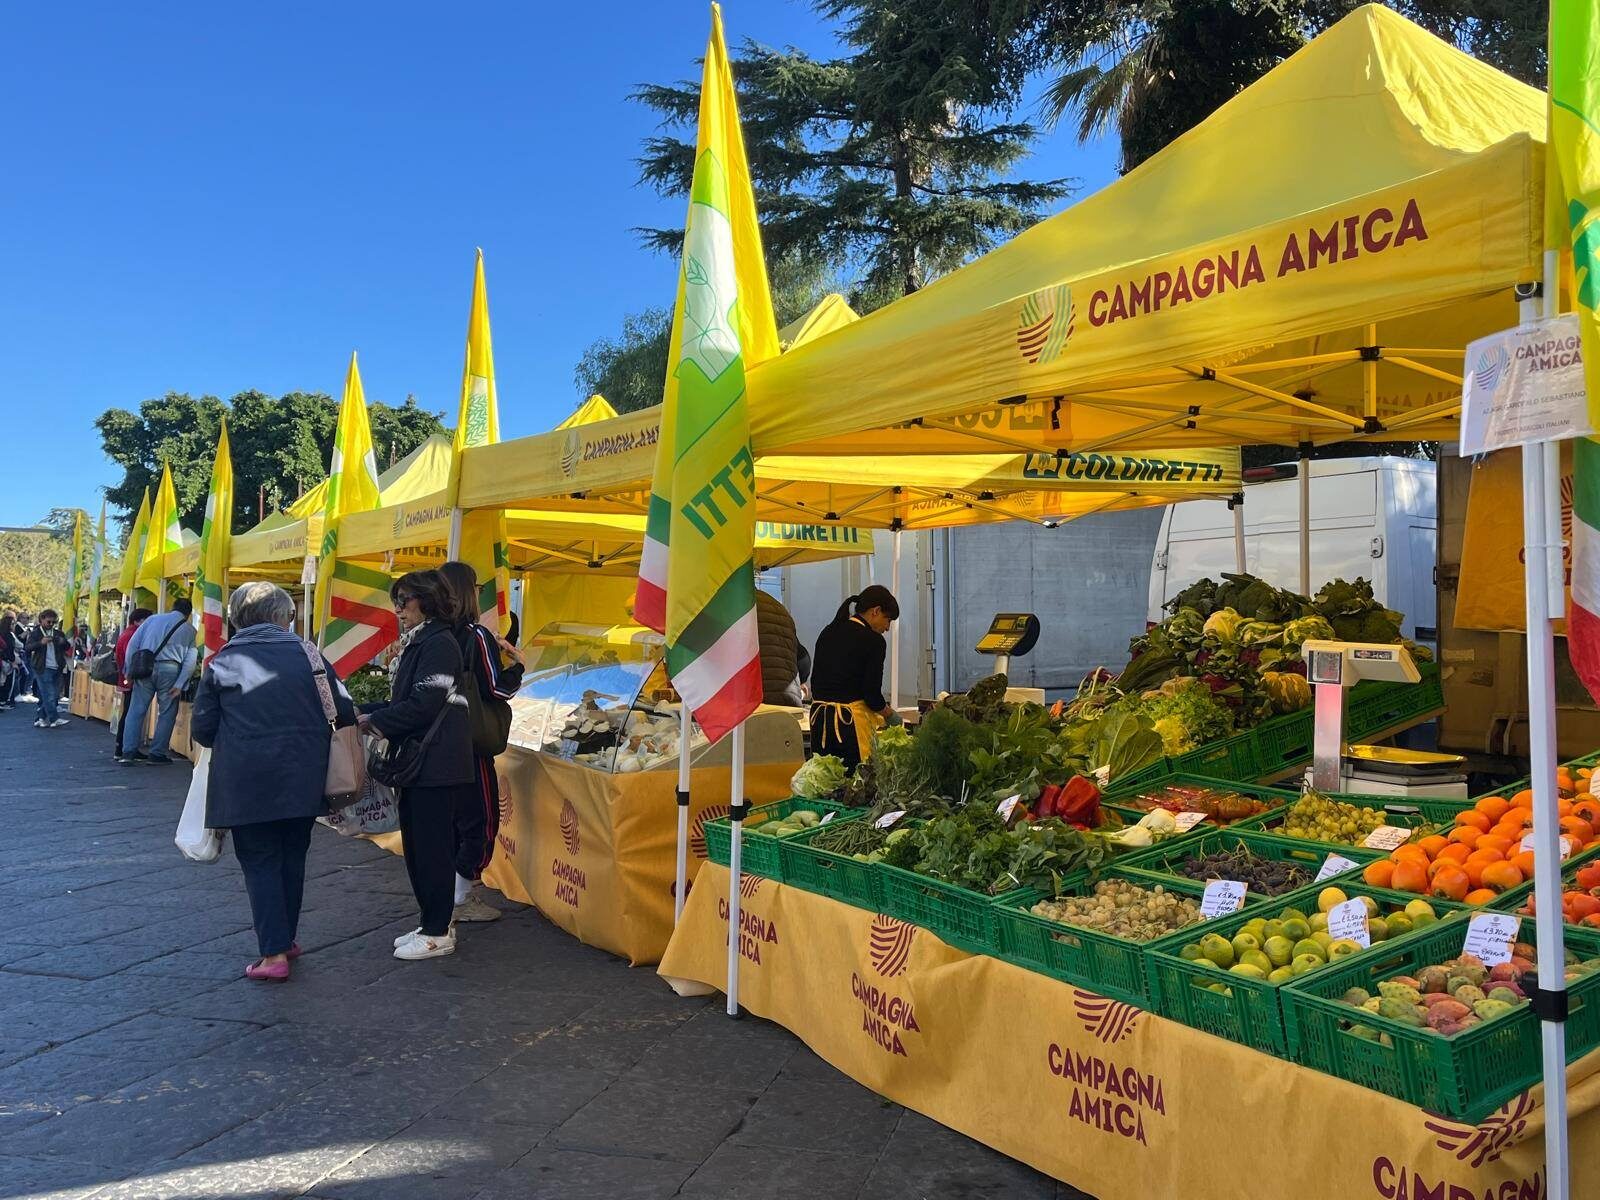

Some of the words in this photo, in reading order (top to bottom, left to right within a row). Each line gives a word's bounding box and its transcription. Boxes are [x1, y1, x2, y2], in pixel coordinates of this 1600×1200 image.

[1088, 244, 1265, 327] CAMPAGNA
[1277, 198, 1428, 278] AMICA
[1528, 350, 1582, 374] AMICA
[583, 432, 635, 461] CAMPAGNA
[1065, 452, 1223, 481] COLDIRETTI
[552, 858, 586, 891] CAMPAGNA
[555, 880, 579, 909] AMICA
[718, 897, 778, 945] CAPAGNA
[851, 972, 921, 1033] CAMPAGNA
[862, 1008, 908, 1058] AMICA
[1048, 1042, 1166, 1117] CAMPAGNA
[1068, 1087, 1148, 1148] AMICA
